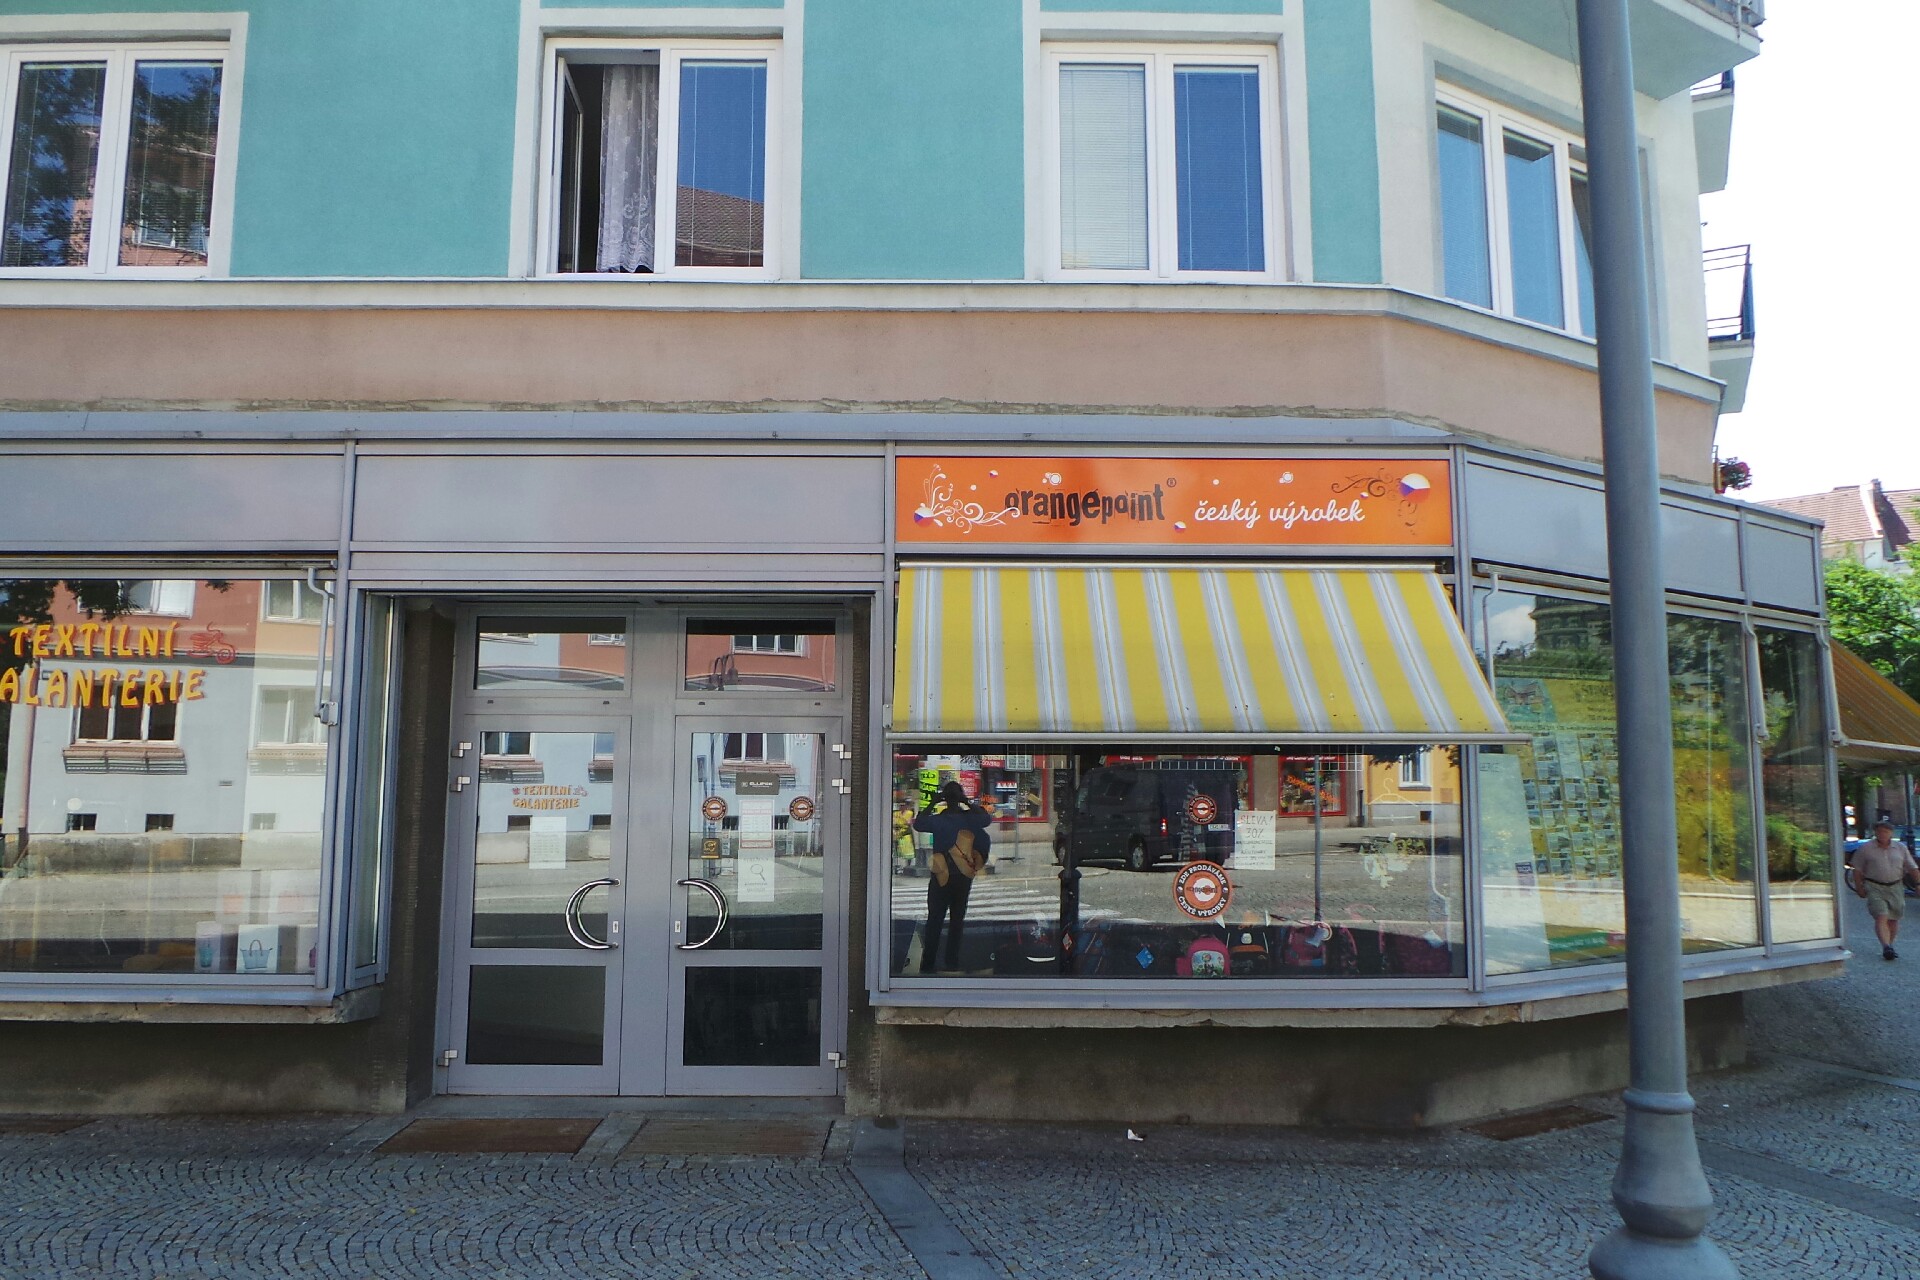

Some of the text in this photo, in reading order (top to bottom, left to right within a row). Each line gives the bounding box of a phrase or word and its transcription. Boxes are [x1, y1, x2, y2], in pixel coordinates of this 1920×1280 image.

[1005, 483, 1166, 527] orangepoint
[1194, 498, 1366, 529] český výrobek
[10, 621, 179, 660] TEXTILNÍ
[0, 667, 207, 709] ALANTERIE
[512, 798, 580, 810] GALANTERIE
[522, 785, 572, 796] TEXTILNÍ
